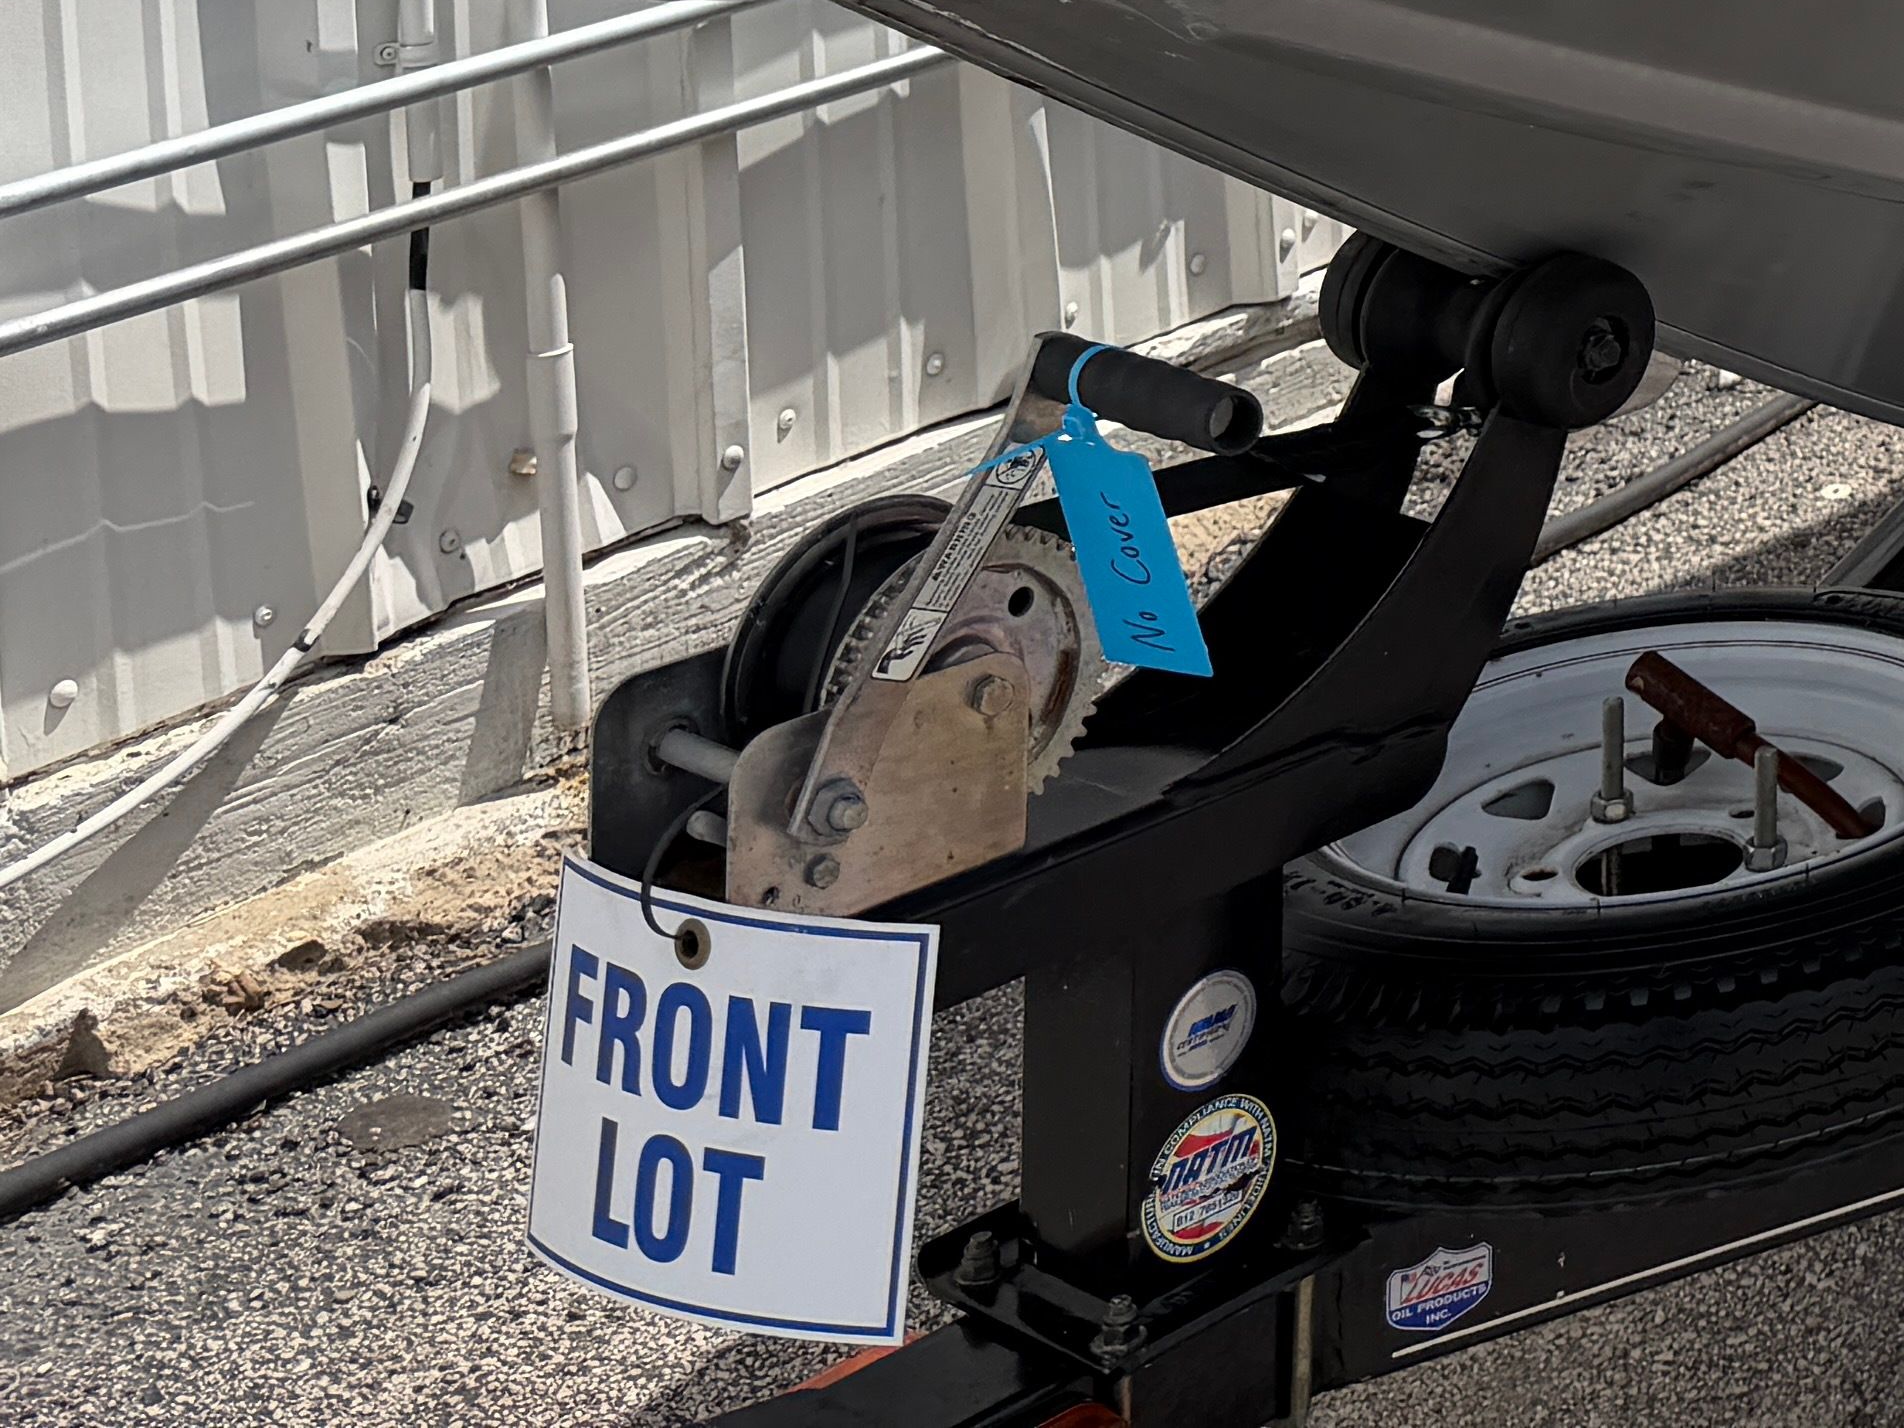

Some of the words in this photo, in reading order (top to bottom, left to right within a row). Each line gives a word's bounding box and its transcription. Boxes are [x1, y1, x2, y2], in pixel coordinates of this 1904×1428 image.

[1100, 491, 1151, 585] Cover
[1122, 611, 1175, 652] No
[561, 944, 872, 1132] FRONT
[1164, 1097, 1237, 1155] COMPLIANCE
[1241, 1097, 1265, 1120] WITH
[592, 1116, 766, 1276] LOT
[1392, 1308, 1414, 1322] OIL
[1417, 1283, 1487, 1313] PRODUCTS
[1401, 1262, 1485, 1305] LUCAS
[1425, 1309, 1452, 1325] INC.
